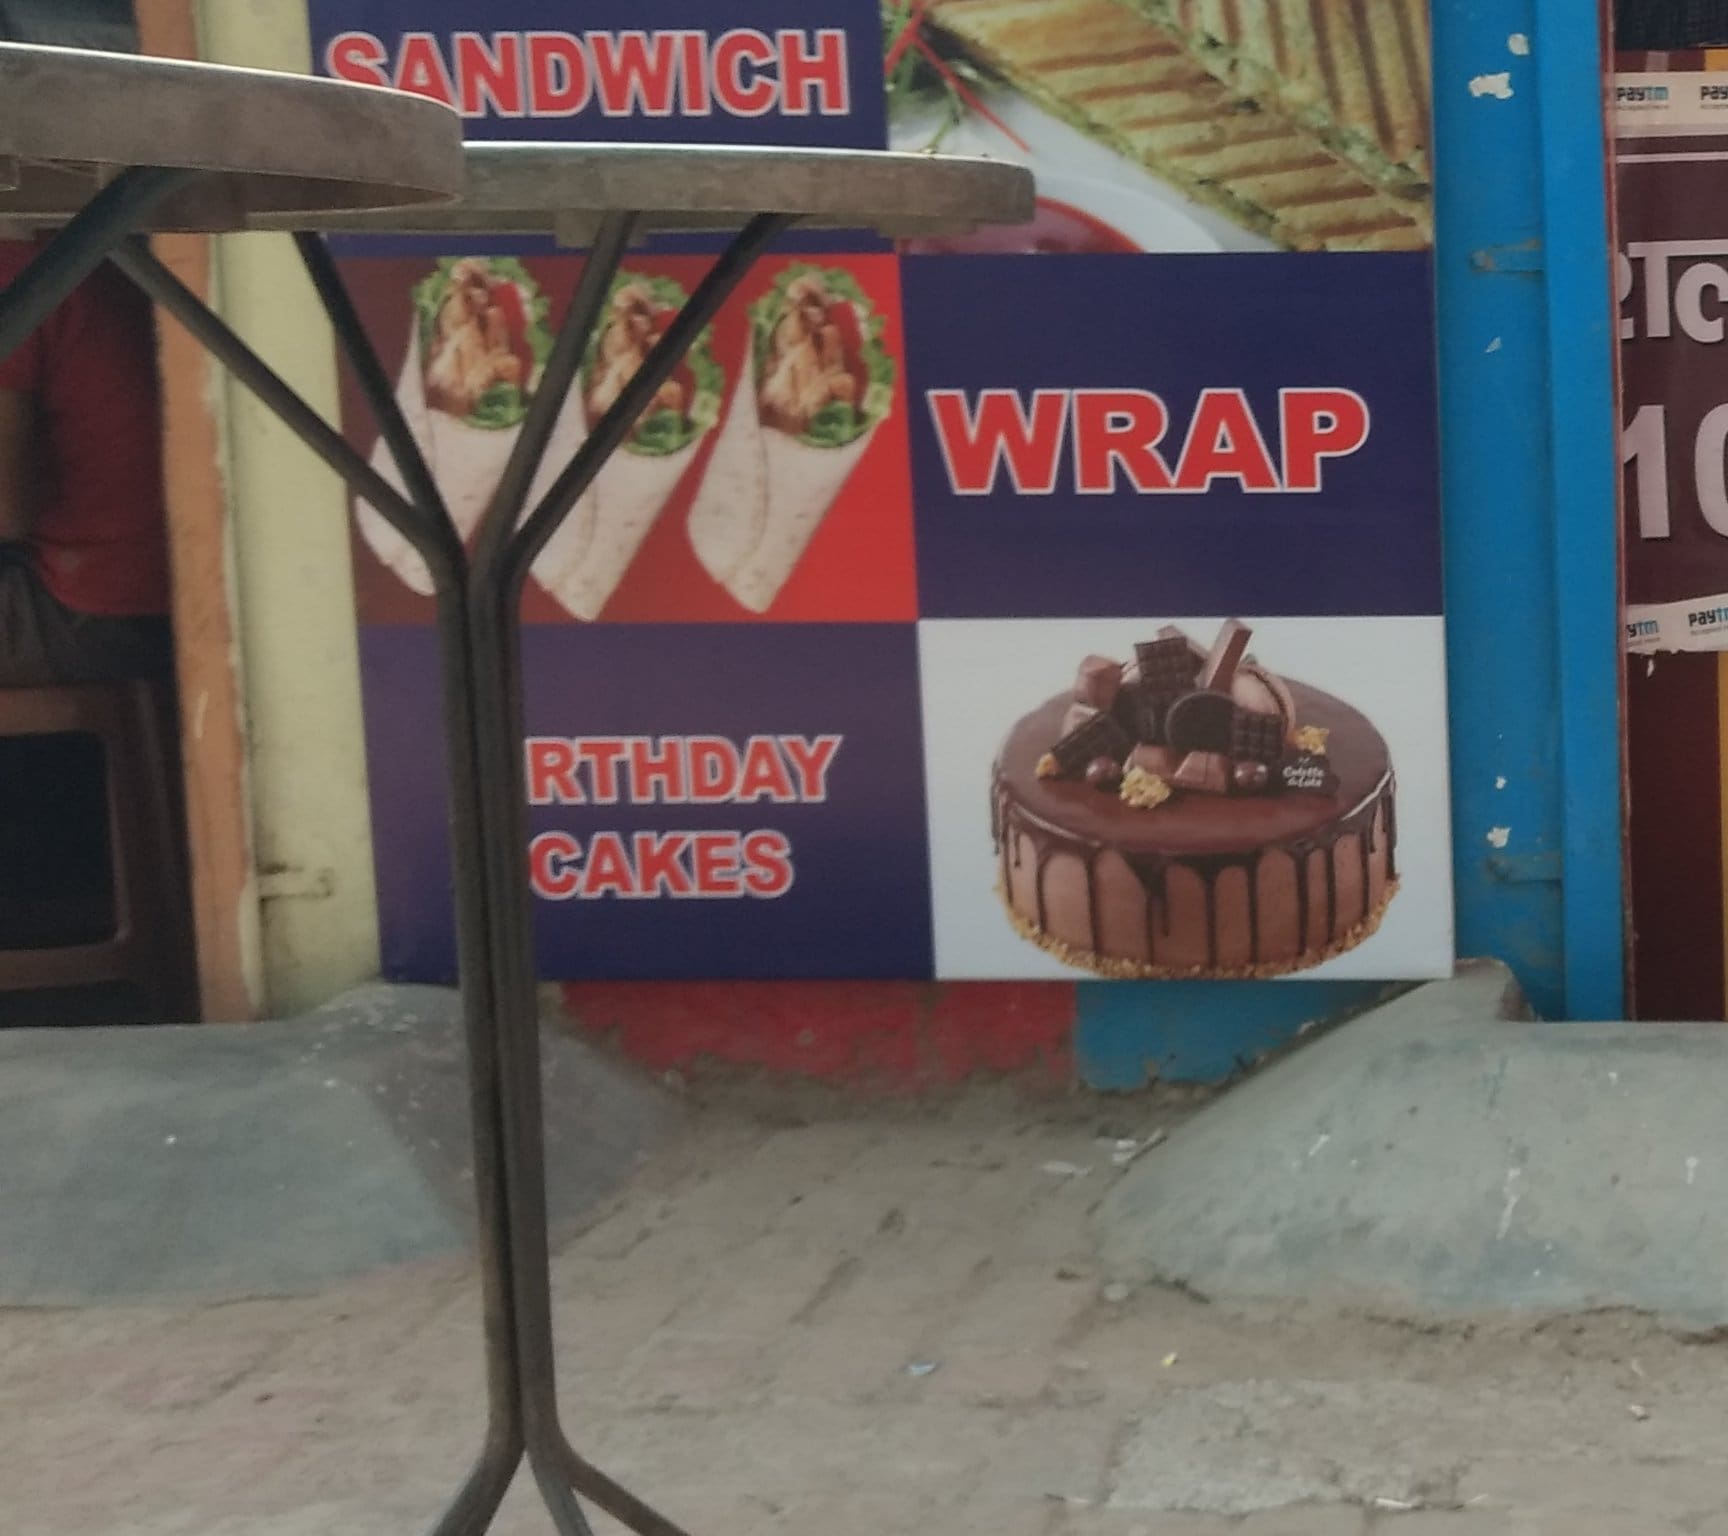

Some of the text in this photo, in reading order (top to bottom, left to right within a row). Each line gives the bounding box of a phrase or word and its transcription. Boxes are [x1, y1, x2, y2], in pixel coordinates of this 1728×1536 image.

[326, 28, 849, 119] SANDWICH
[926, 386, 1371, 496] WRAP
[1626, 620, 1659, 638] ytm
[525, 735, 843, 805] RTHDAY
[529, 830, 794, 900] CAKES
